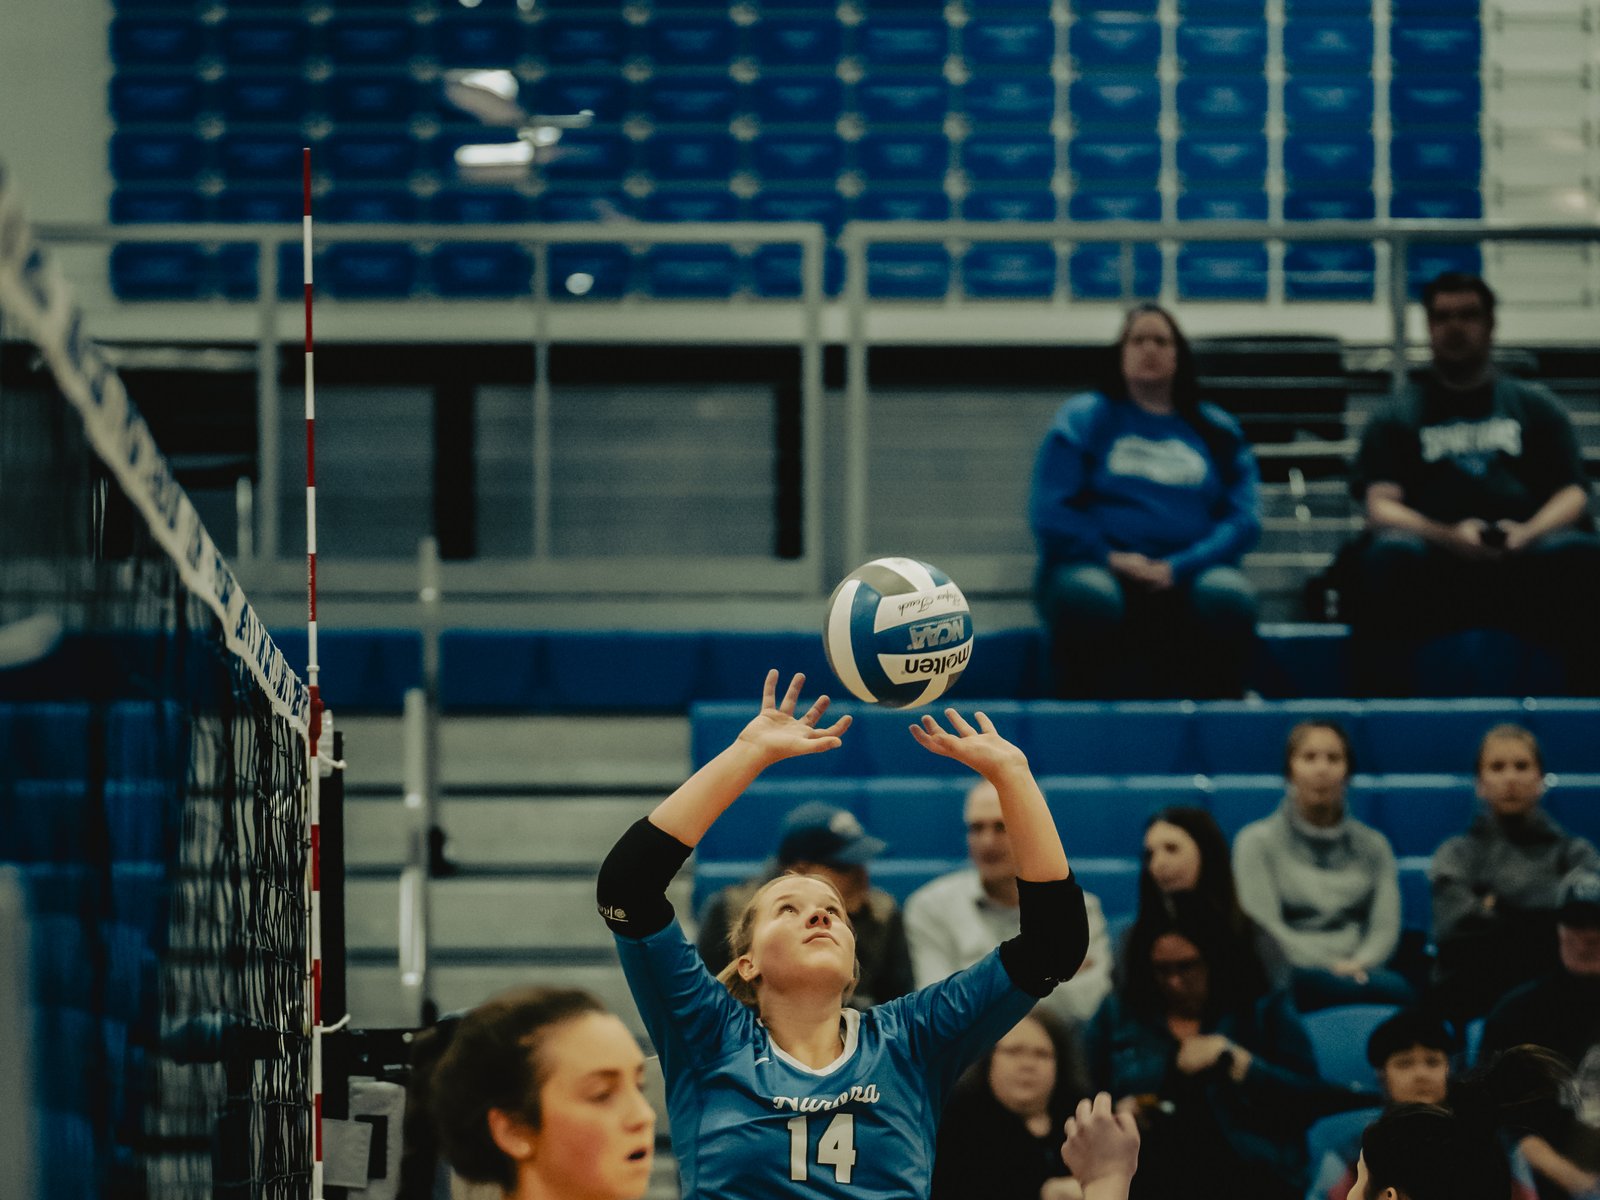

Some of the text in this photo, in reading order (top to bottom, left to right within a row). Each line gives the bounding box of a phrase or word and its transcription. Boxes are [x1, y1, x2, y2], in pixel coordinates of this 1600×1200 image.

[897, 596, 935, 618] Touch
[908, 615, 965, 650] NCAA
[904, 644, 971, 675] molten
[787, 1113, 857, 1184] 14
